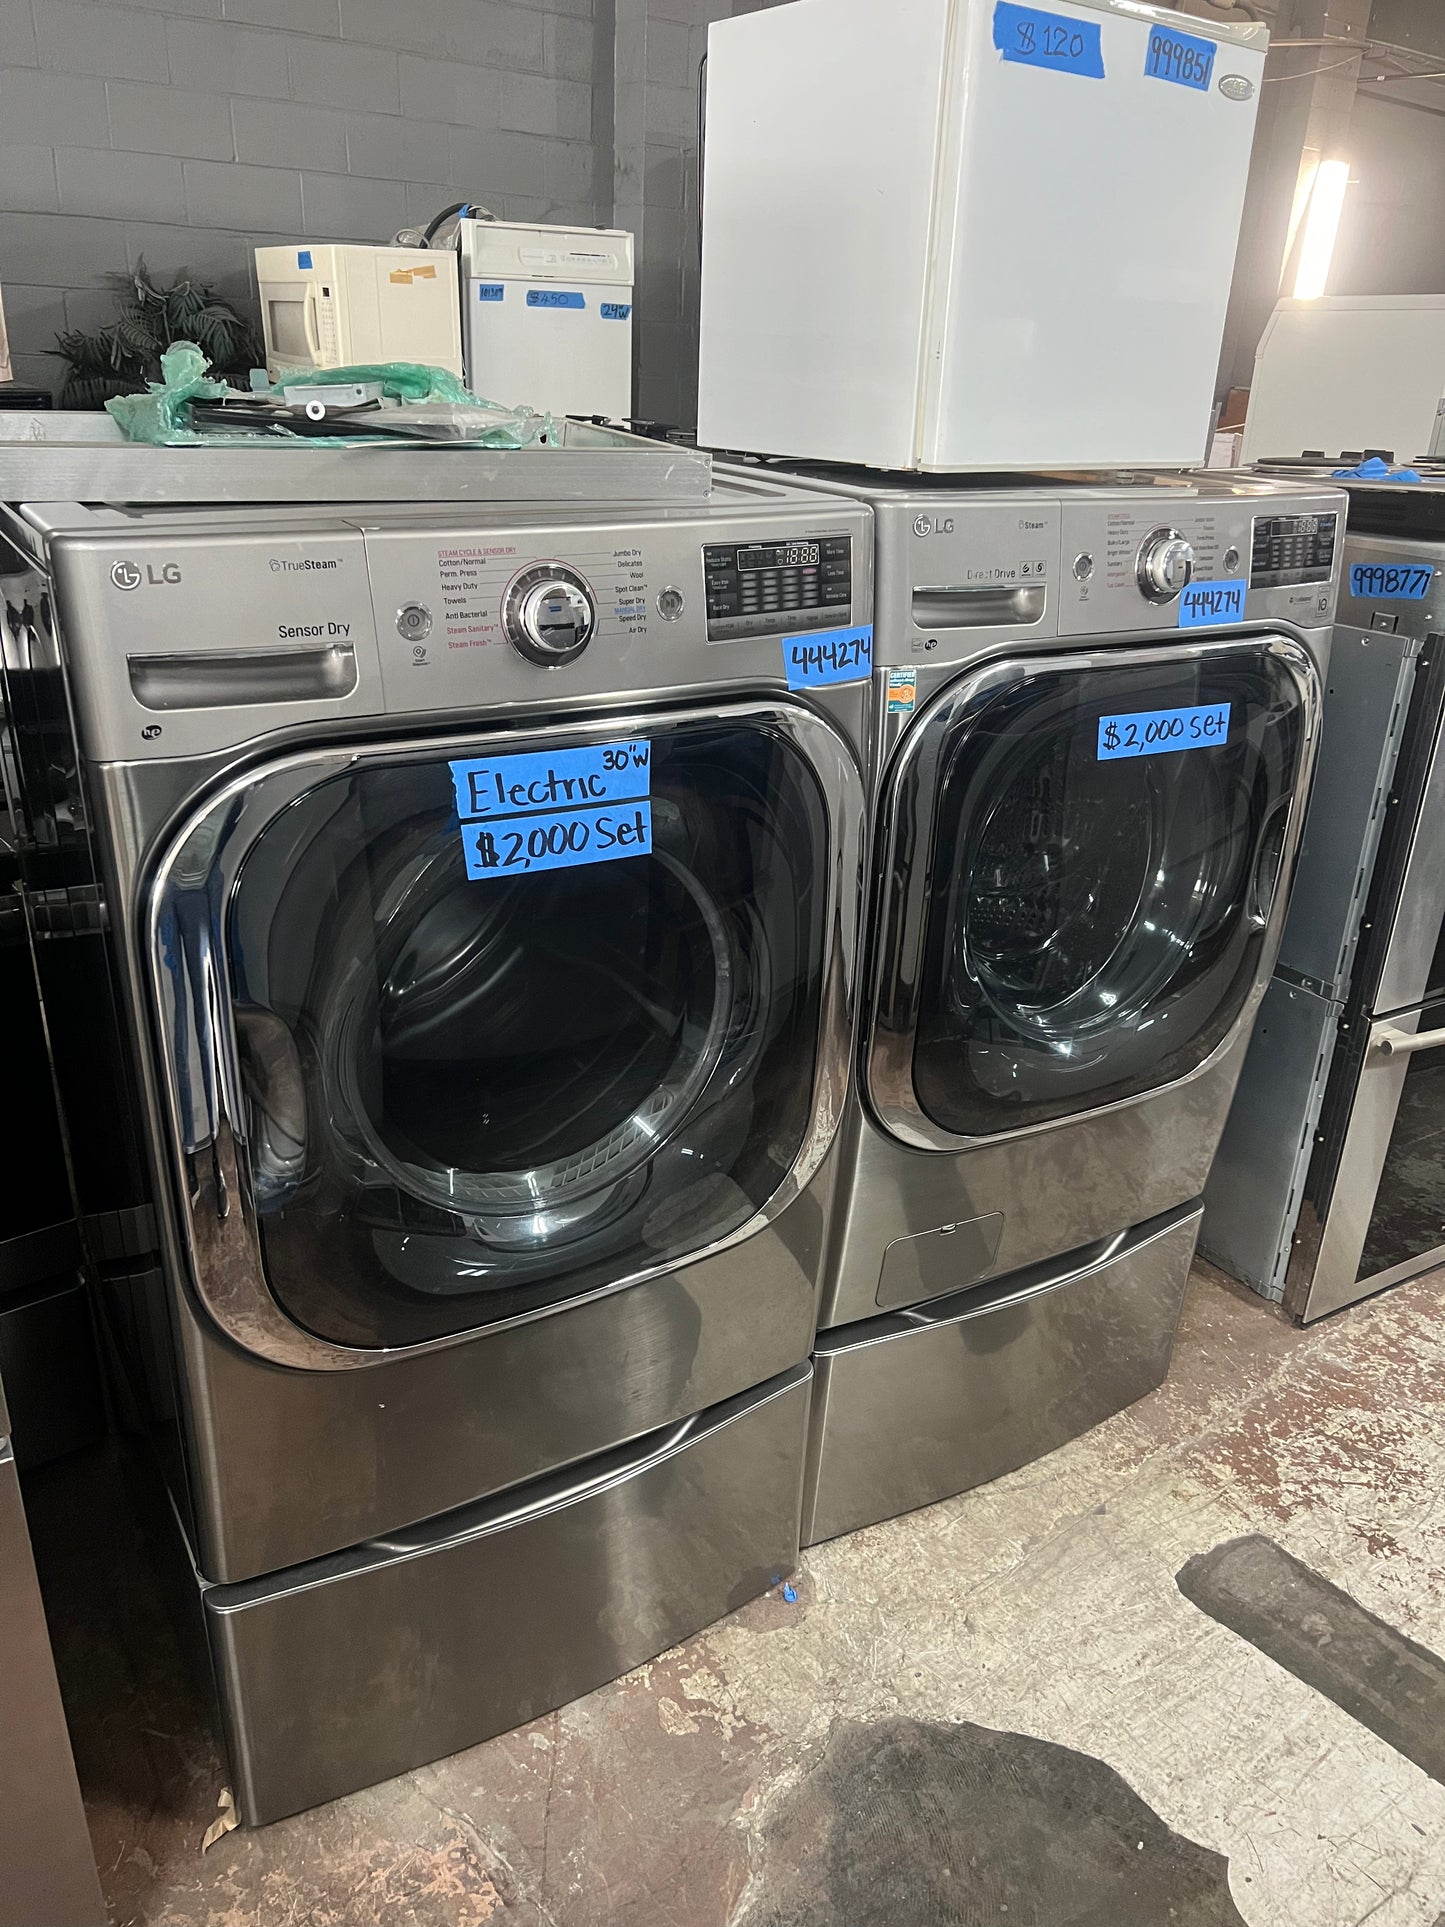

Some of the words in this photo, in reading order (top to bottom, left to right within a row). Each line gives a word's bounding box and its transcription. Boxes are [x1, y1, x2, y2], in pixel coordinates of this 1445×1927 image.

[933, 518, 955, 534] LG
[631, 549, 642, 557] Dry
[617, 560, 643, 568] Delicates
[146, 563, 182, 585] LG
[460, 569, 478, 577] Press
[441, 583, 462, 592] Heavy
[463, 582, 479, 591] Duty
[443, 596, 467, 605] Towels
[618, 599, 635, 607] Super
[635, 596, 646, 604] Dry
[1183, 589, 1241, 619] 444274
[445, 612, 459, 620] Anti
[460, 610, 488, 618] Bacterial
[619, 614, 637, 623] Speed
[637, 613, 647, 622] Dry
[278, 625, 325, 639] Sensor
[328, 621, 350, 638] Dry
[447, 626, 467, 635] Steam
[637, 625, 648, 634] Dry
[448, 641, 469, 650] Steam
[791, 636, 871, 675] 444274
[1102, 717, 1184, 753] $2,000
[467, 769, 607, 814] Electric
[473, 820, 590, 869] $2,000
[595, 811, 648, 850] Set
